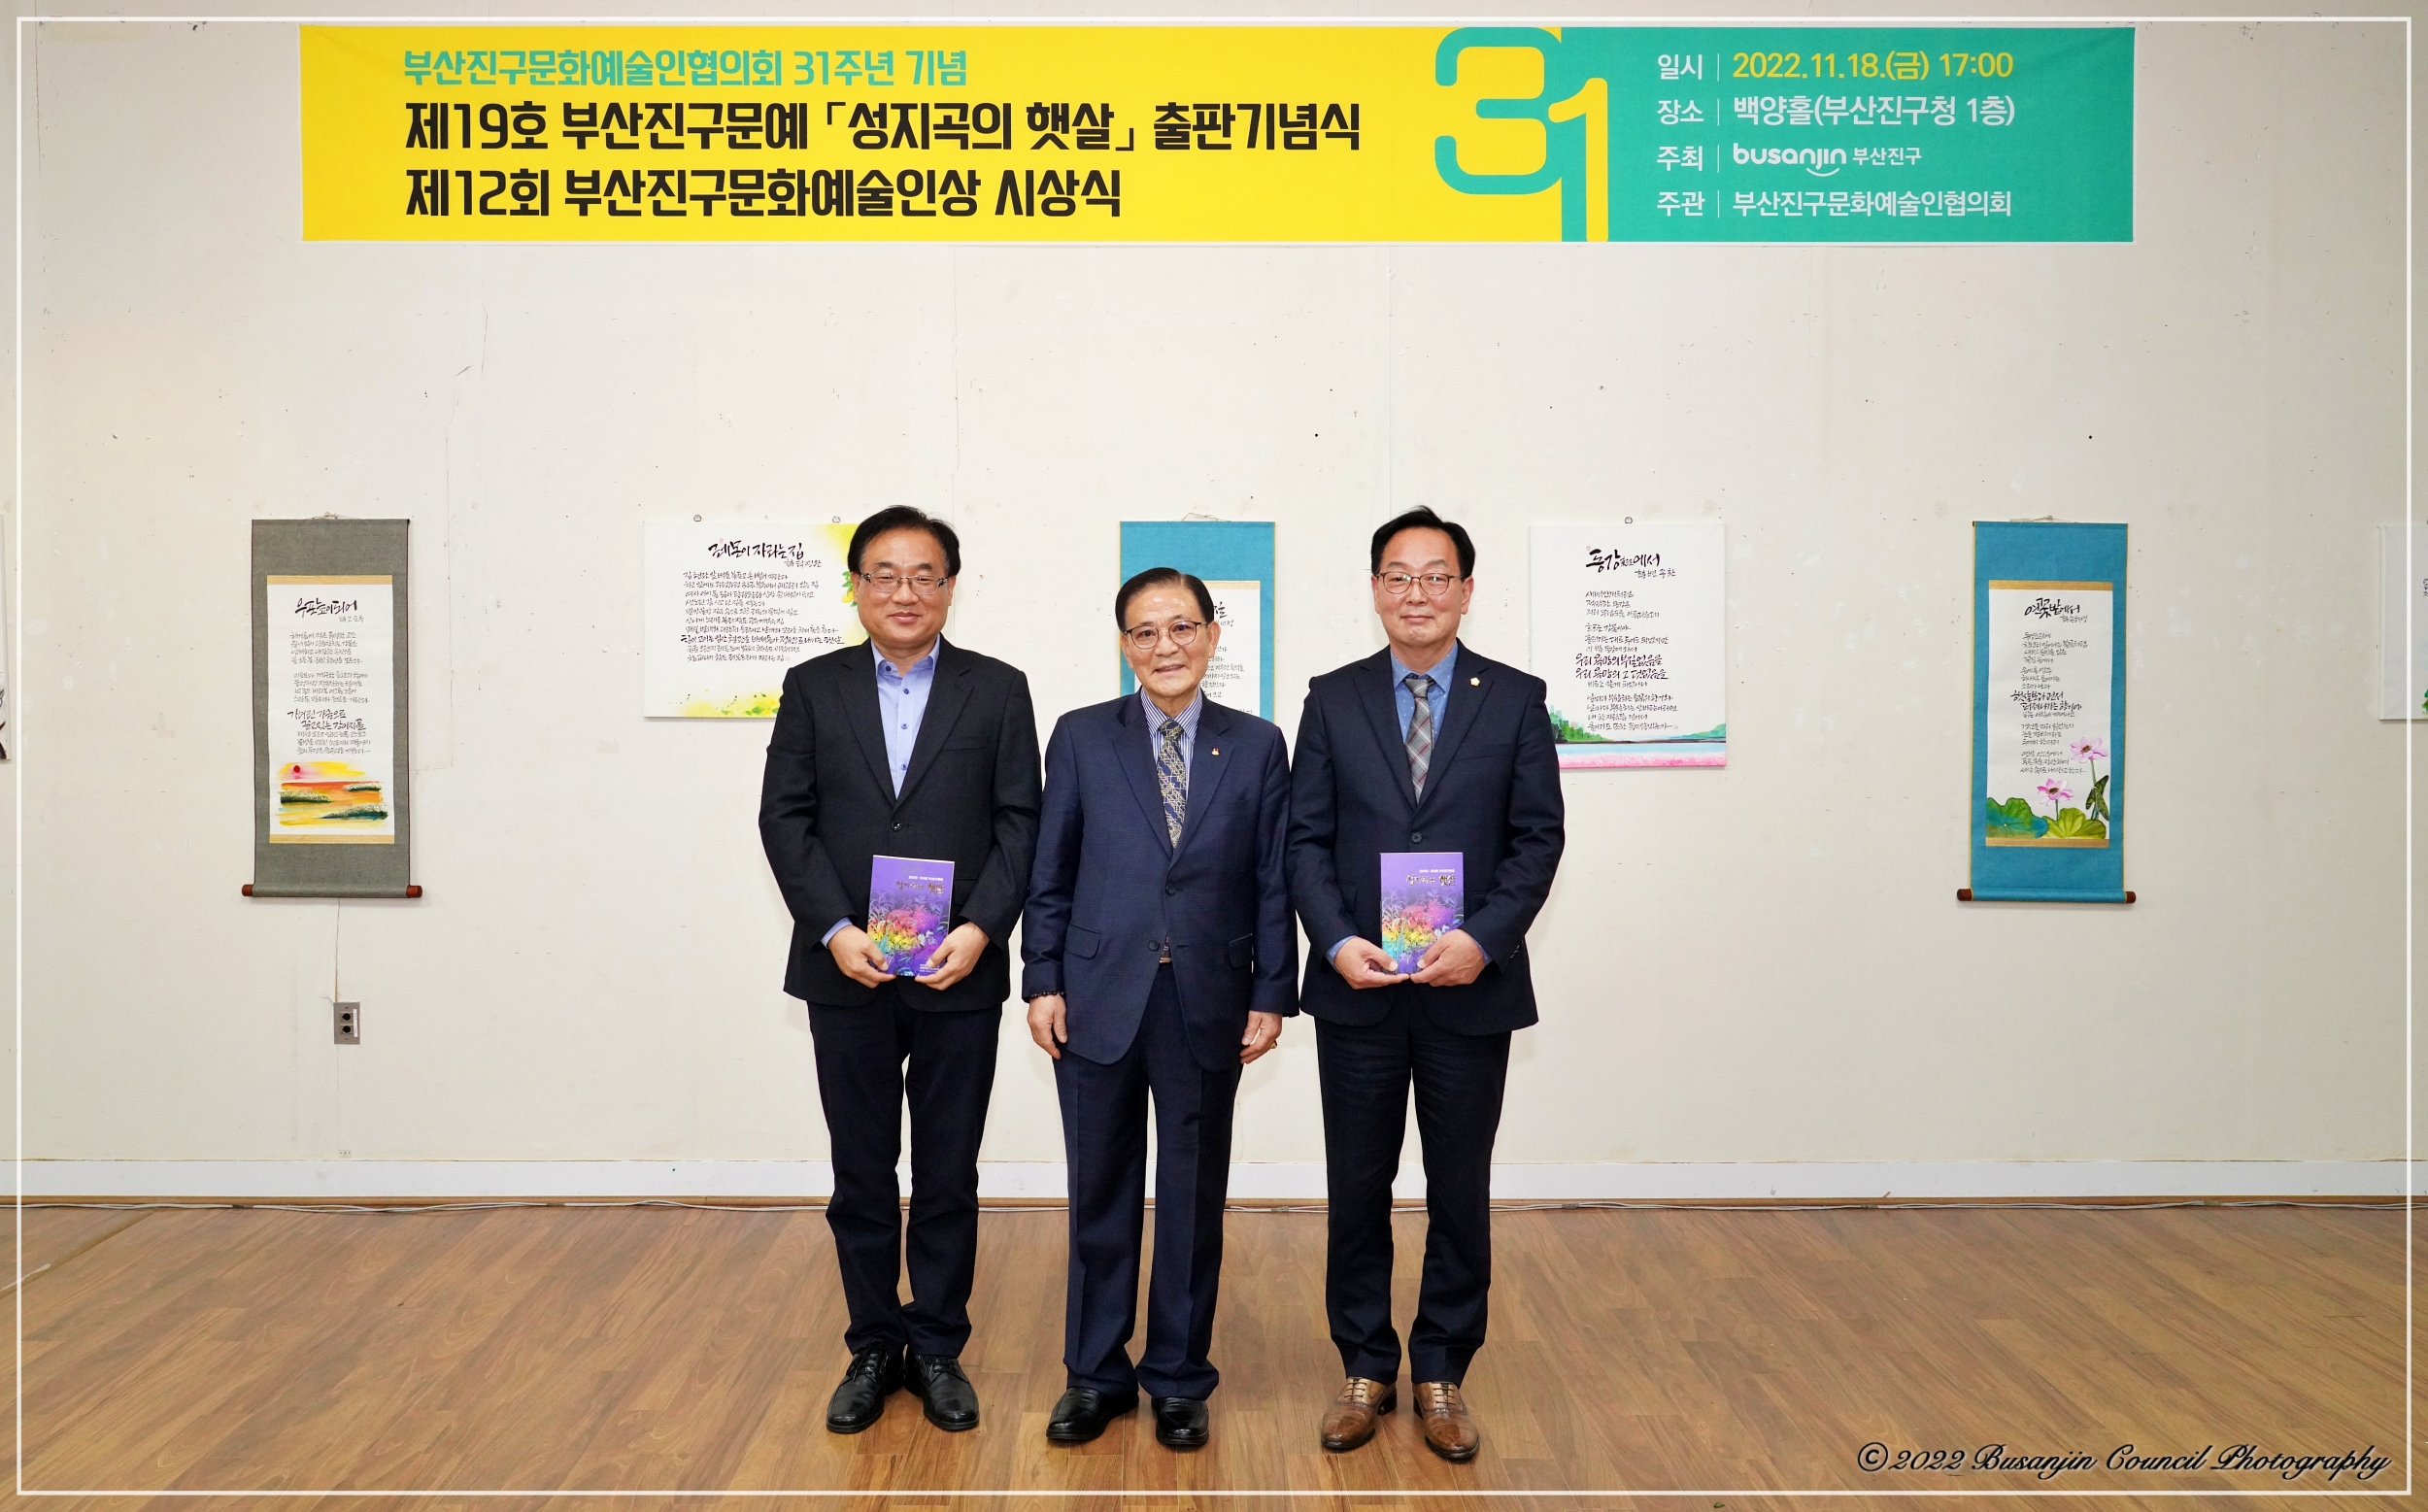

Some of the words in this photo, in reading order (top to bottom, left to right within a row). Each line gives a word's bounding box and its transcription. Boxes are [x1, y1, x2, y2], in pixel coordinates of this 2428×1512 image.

[405, 50, 782, 85] 부산진구문화예술인협의회
[794, 50, 894, 85] 31주년
[906, 50, 966, 85] 기념
[1658, 54, 1702, 80] 일시
[1733, 50, 1930, 80] 2022.11.18.(금)
[1939, 52, 2013, 78] 17:00
[406, 101, 548, 149] 제19호
[562, 103, 807, 150] 부산진구문예
[827, 102, 1011, 150] 「성지곡의
[1027, 102, 1133, 151] 햇살」
[1154, 102, 1359, 151] 출판기념식
[1657, 100, 1703, 124] 장소
[1735, 95, 1955, 125] 백양홀(부산진구청
[1968, 95, 2014, 125] 1층)
[1657, 146, 1703, 171] 주최
[1734, 143, 1846, 177] busanjin
[1853, 148, 1922, 165] 부산진구
[406, 168, 549, 216] 제12회
[565, 168, 981, 217] 부산진구문화예술인상
[995, 170, 1120, 217] 시상식
[1657, 191, 1705, 217] 주관
[1733, 191, 2010, 217] 부산진구문화예술인협의회
